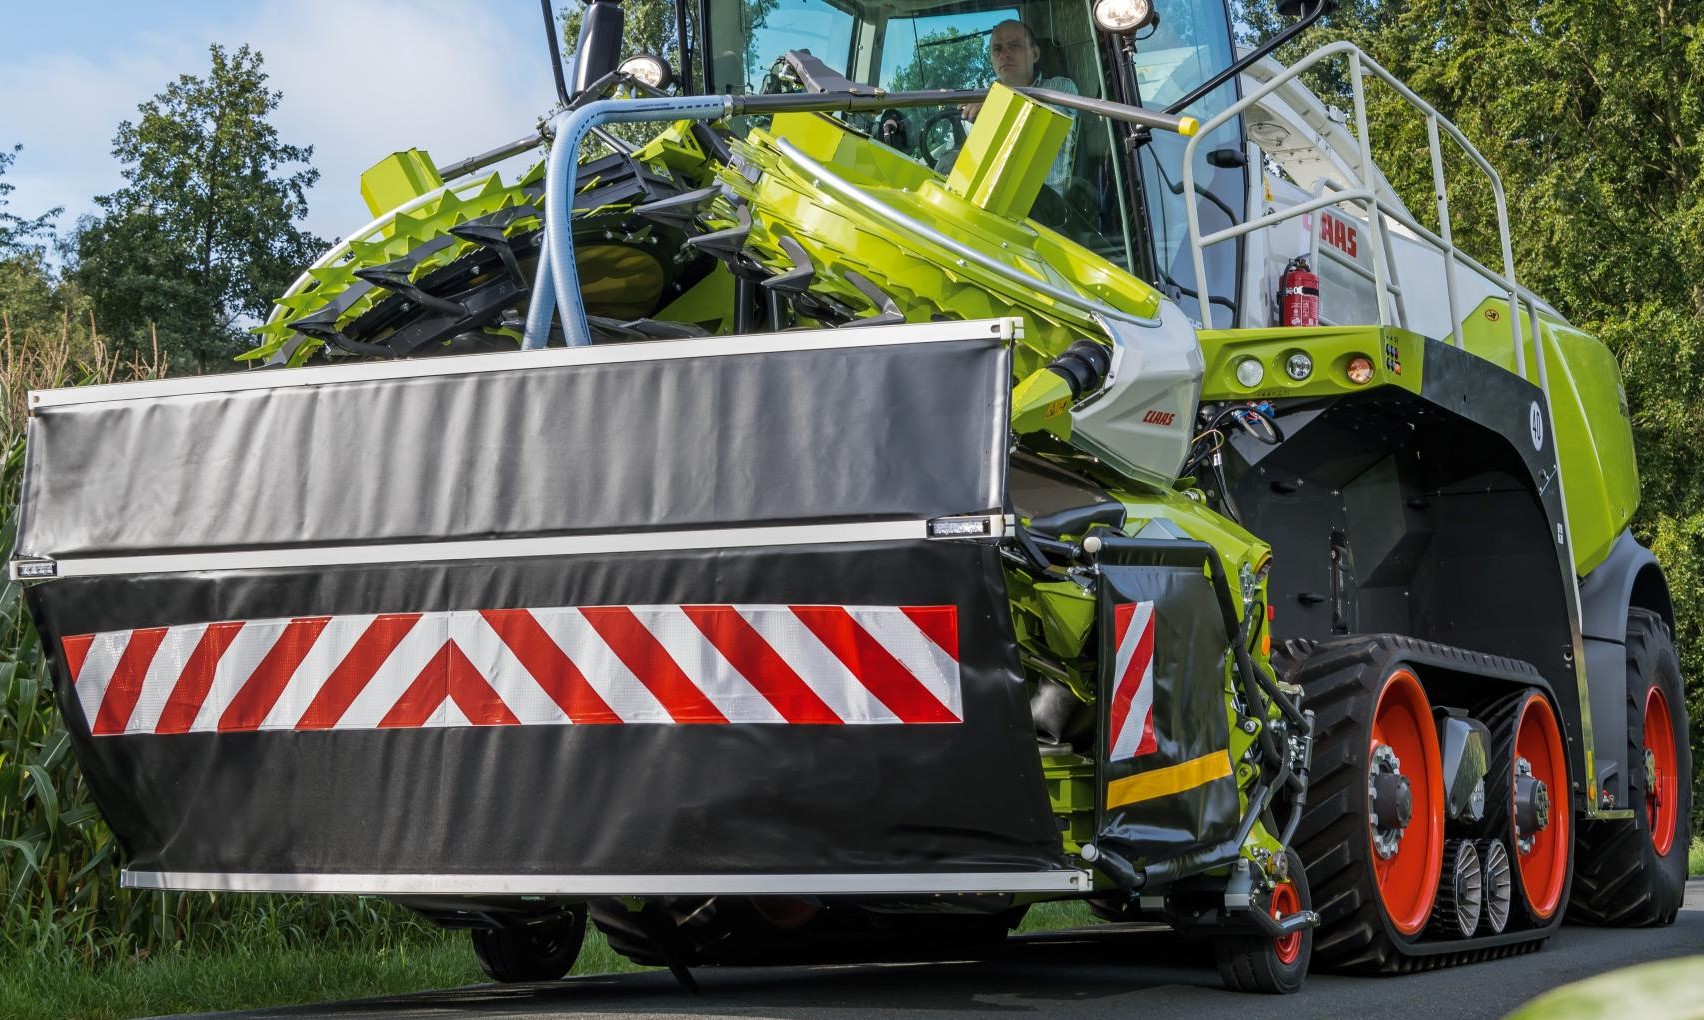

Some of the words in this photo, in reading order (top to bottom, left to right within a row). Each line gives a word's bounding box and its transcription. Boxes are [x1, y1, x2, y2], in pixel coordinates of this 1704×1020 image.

[1303, 207, 1357, 258] CAAS
[1143, 410, 1176, 426] CLAAS
[1532, 409, 1541, 441] 40
